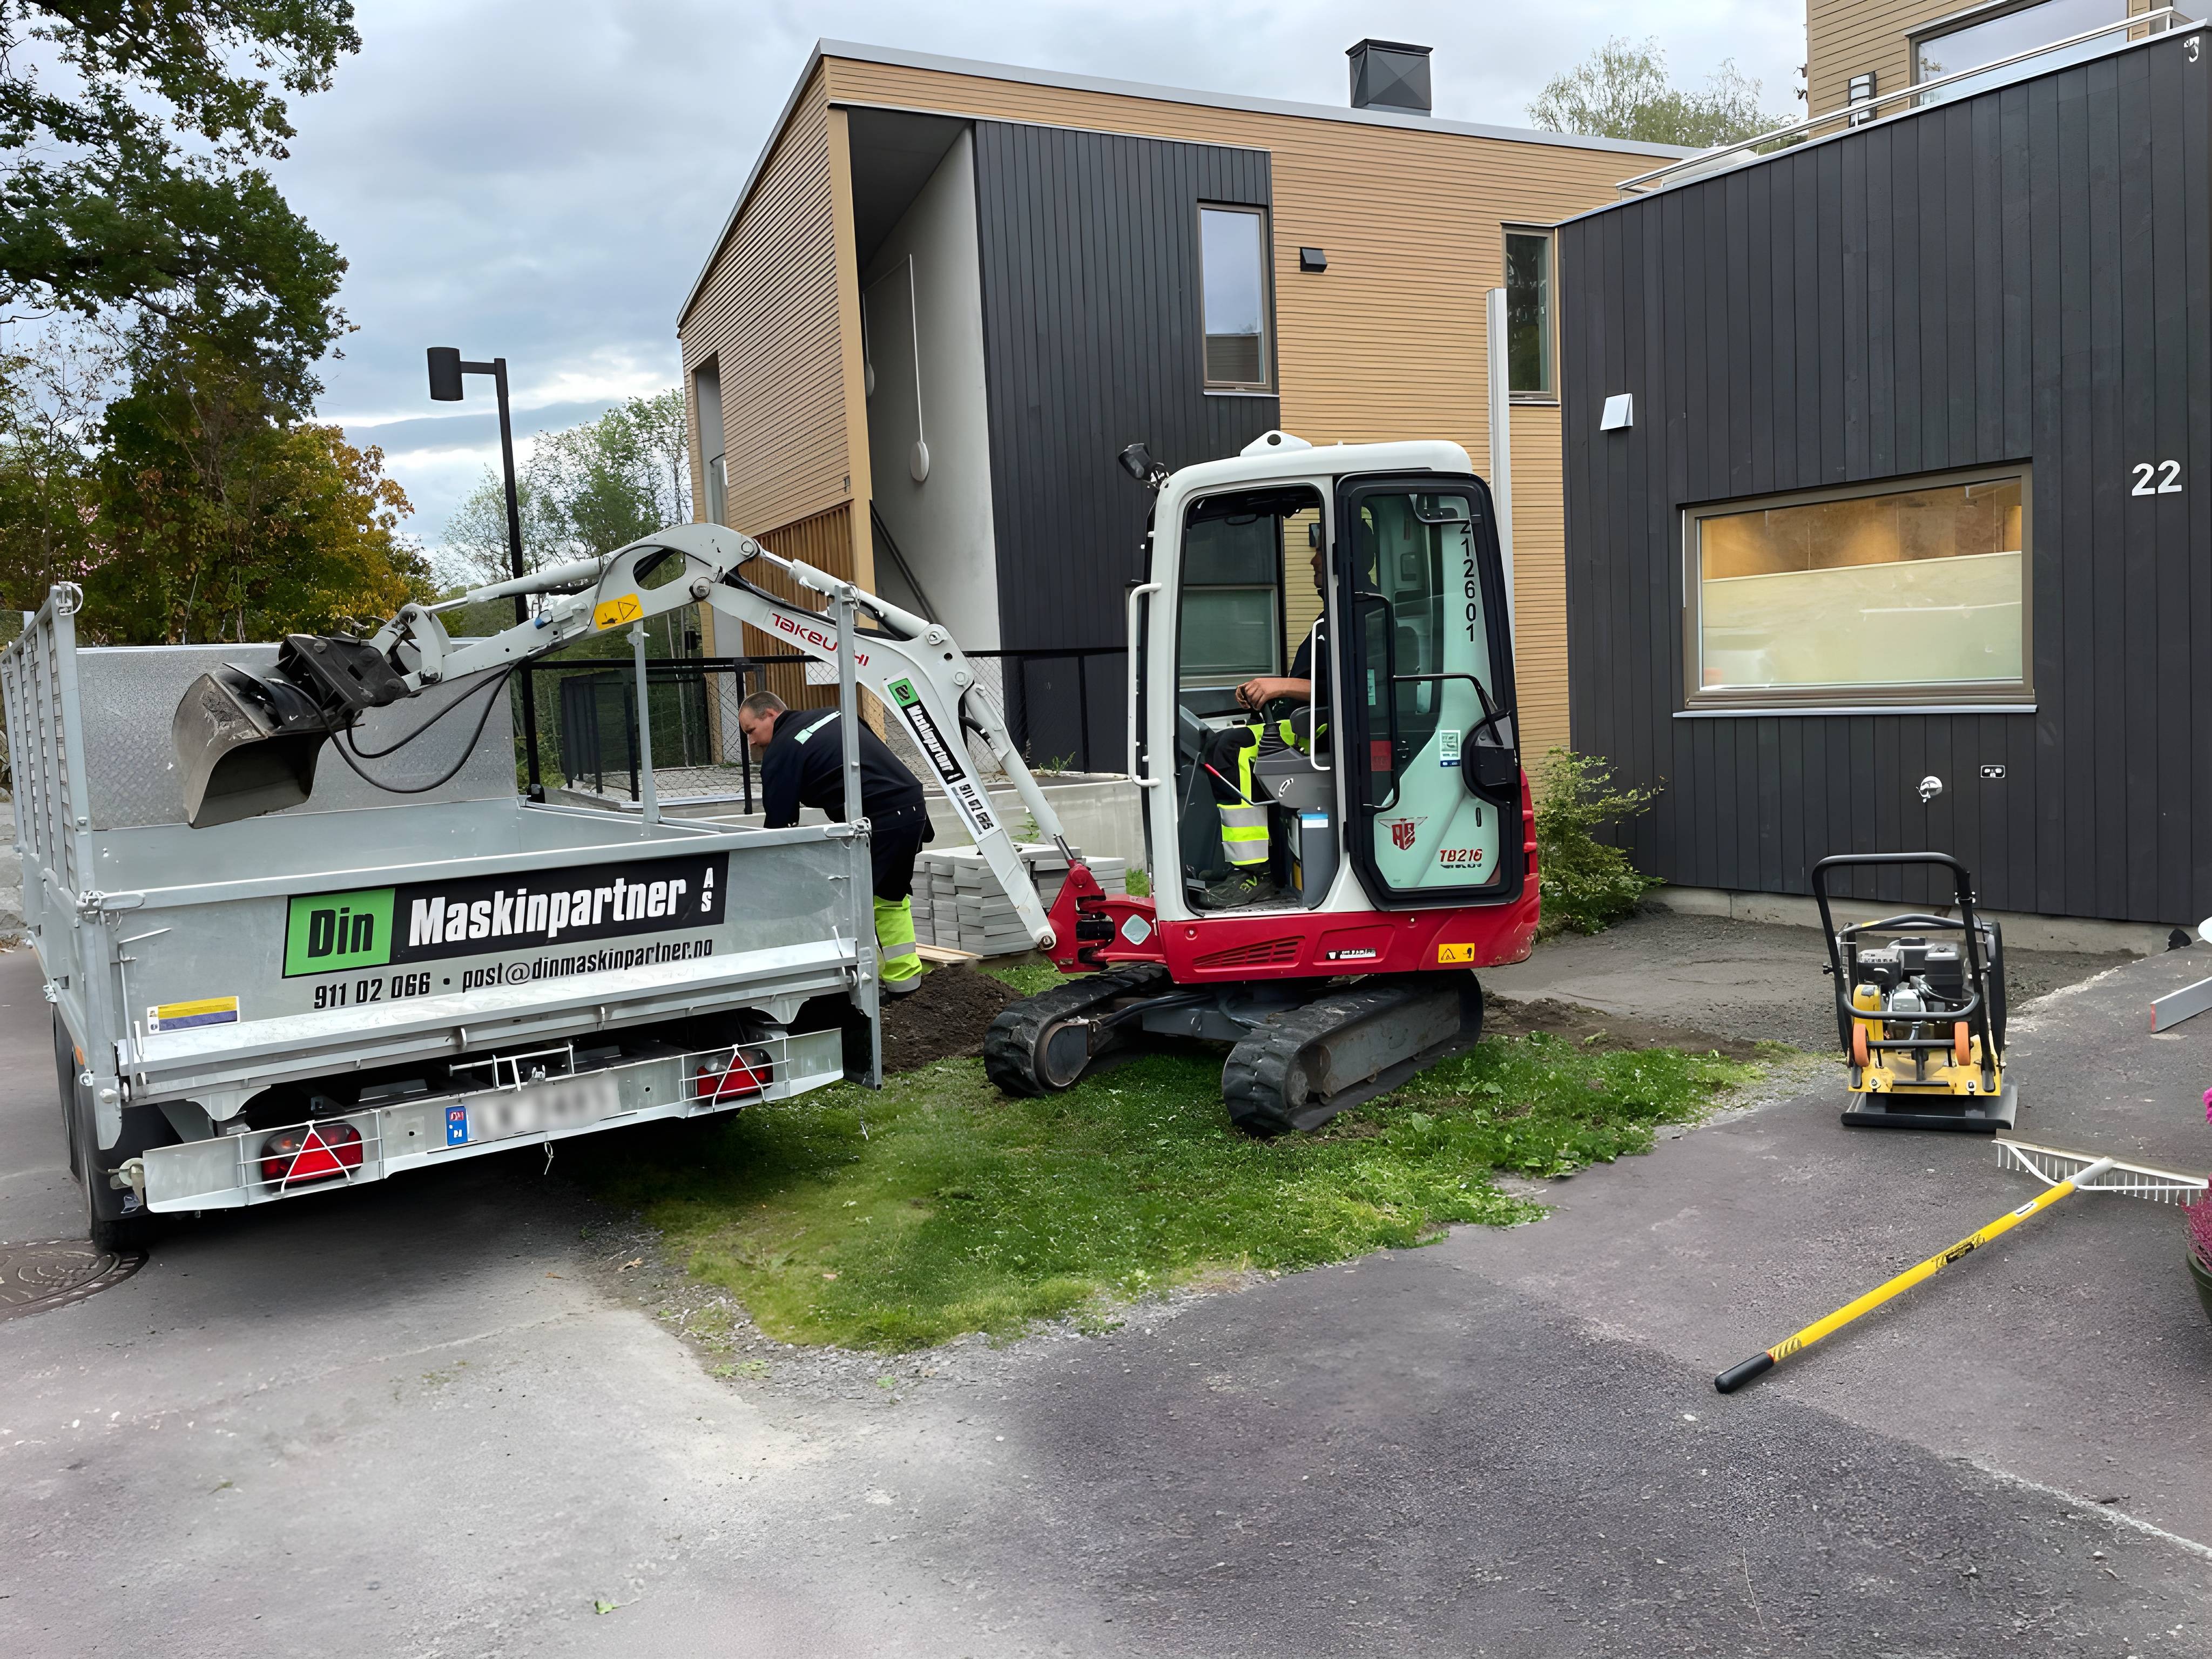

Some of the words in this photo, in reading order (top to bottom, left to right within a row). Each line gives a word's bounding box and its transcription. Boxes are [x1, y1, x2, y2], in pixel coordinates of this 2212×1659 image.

[2132, 460, 2182, 496] 22
[308, 907, 374, 957] Din
[409, 878, 686, 946] Maskinpartner
[314, 983, 346, 1009] 911
[355, 979, 382, 1003] 02
[390, 972, 430, 999] 066
[462, 939, 713, 993] post@dinmaskinpartner.no
